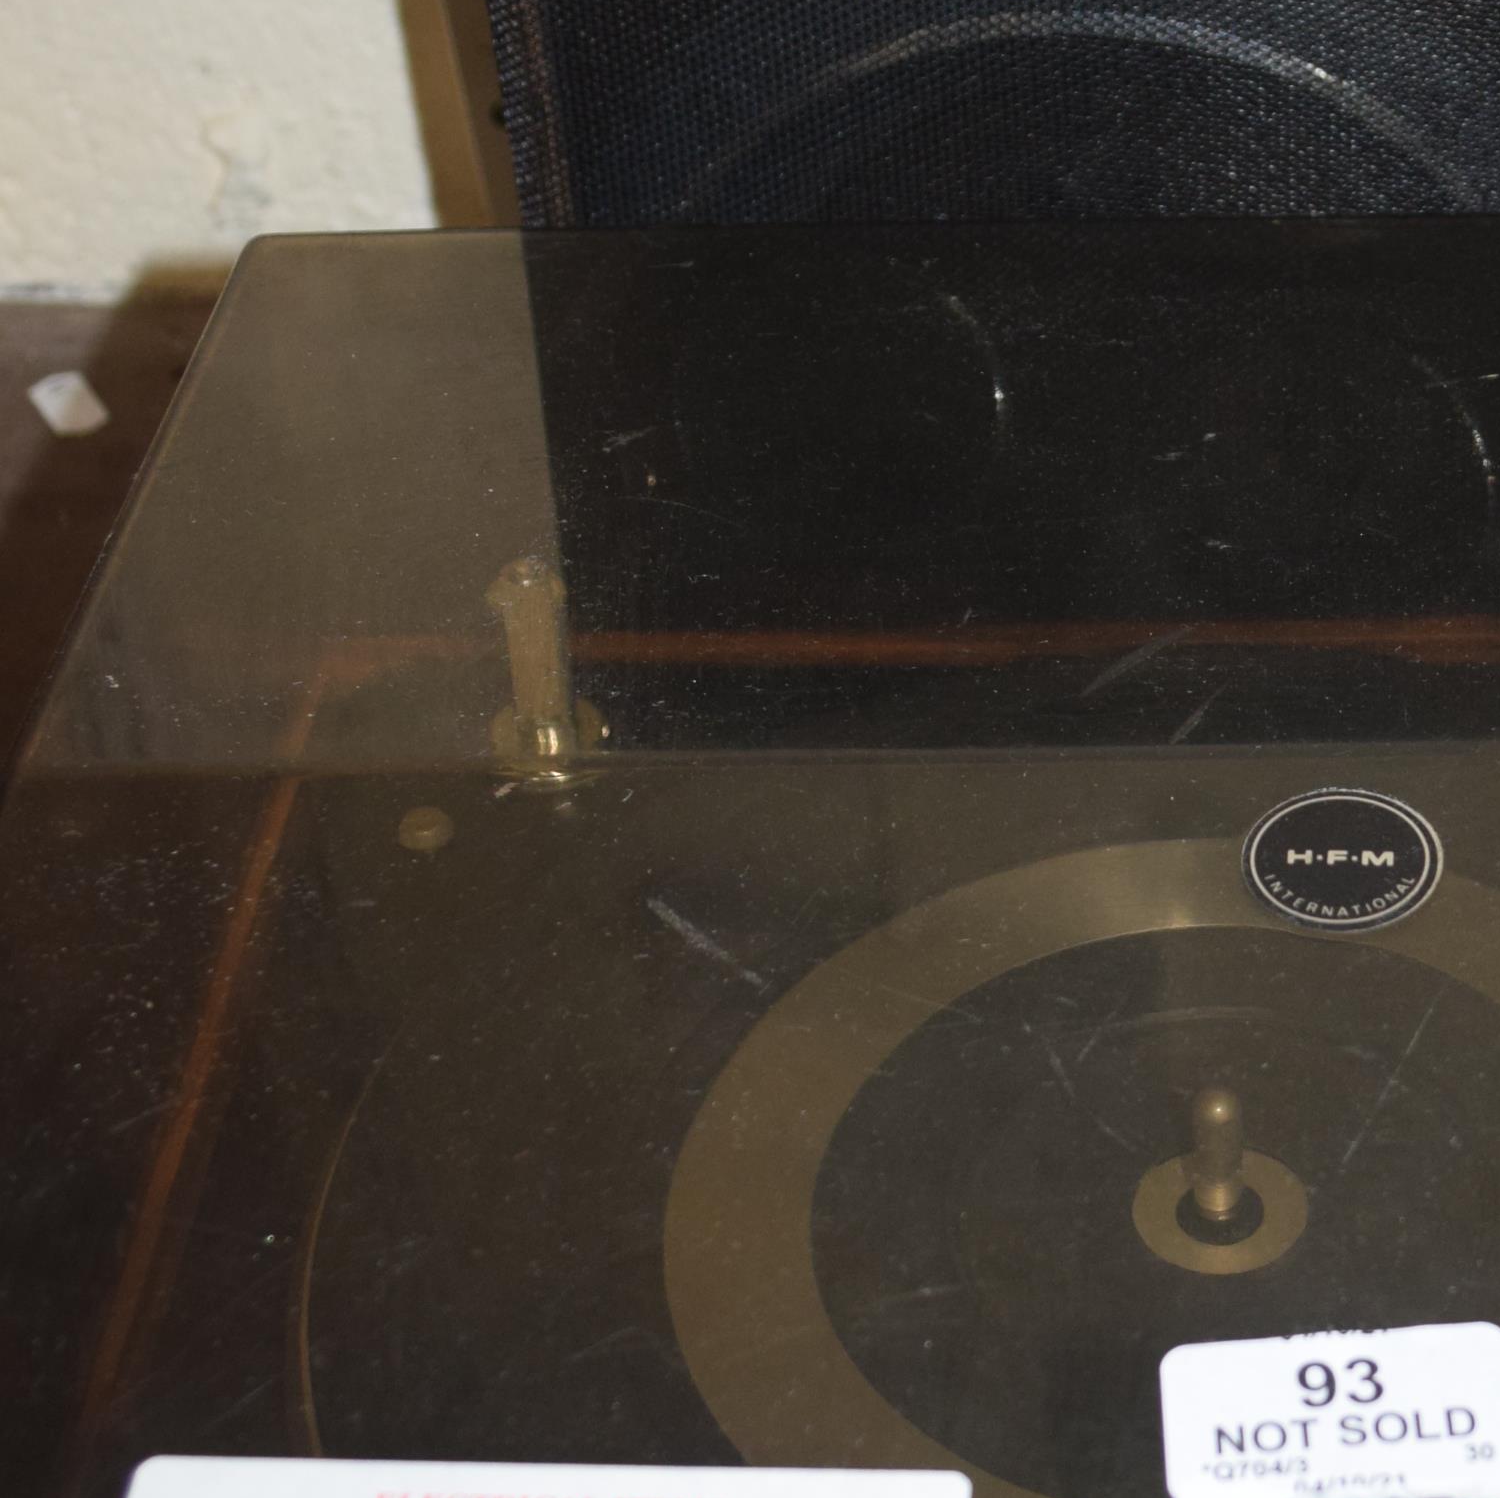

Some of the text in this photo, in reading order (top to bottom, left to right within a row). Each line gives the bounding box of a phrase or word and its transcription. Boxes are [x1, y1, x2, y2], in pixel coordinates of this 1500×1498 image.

[1264, 873, 1416, 917] INTERNATIONAL
[1297, 1358, 1384, 1407] 93
[1214, 1407, 1477, 1455] NOT SOLD
